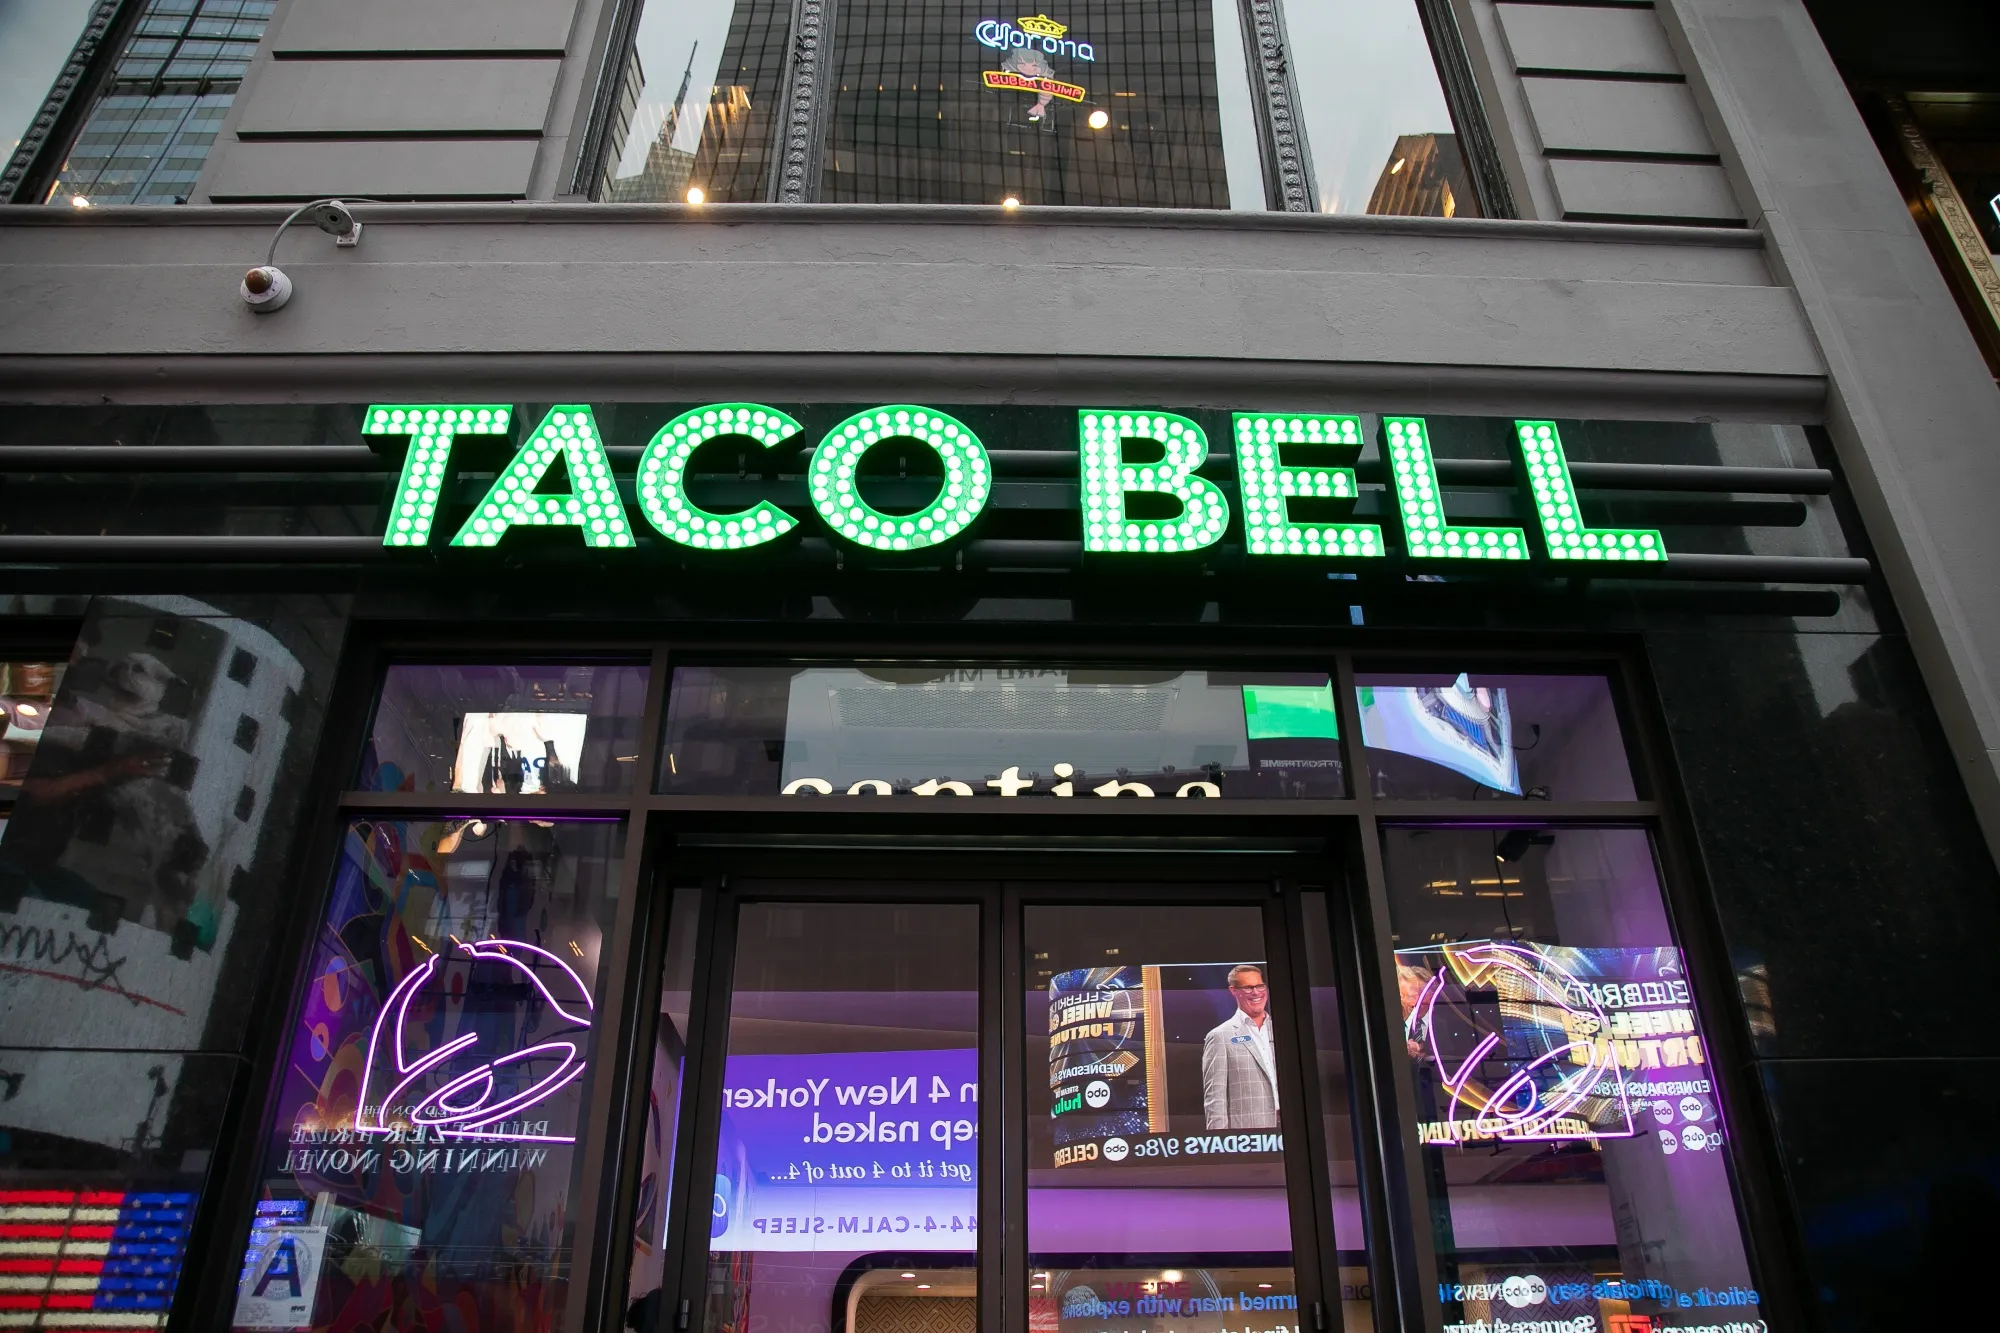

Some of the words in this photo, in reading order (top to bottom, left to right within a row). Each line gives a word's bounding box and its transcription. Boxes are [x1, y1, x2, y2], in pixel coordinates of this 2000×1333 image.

[976, 20, 1094, 61] Corona
[988, 73, 1037, 89] BUBBA
[1041, 79, 1082, 98] GUMP
[362, 402, 992, 551] TACO
[1078, 408, 1667, 560] BELL
[251, 1238, 302, 1297] A
